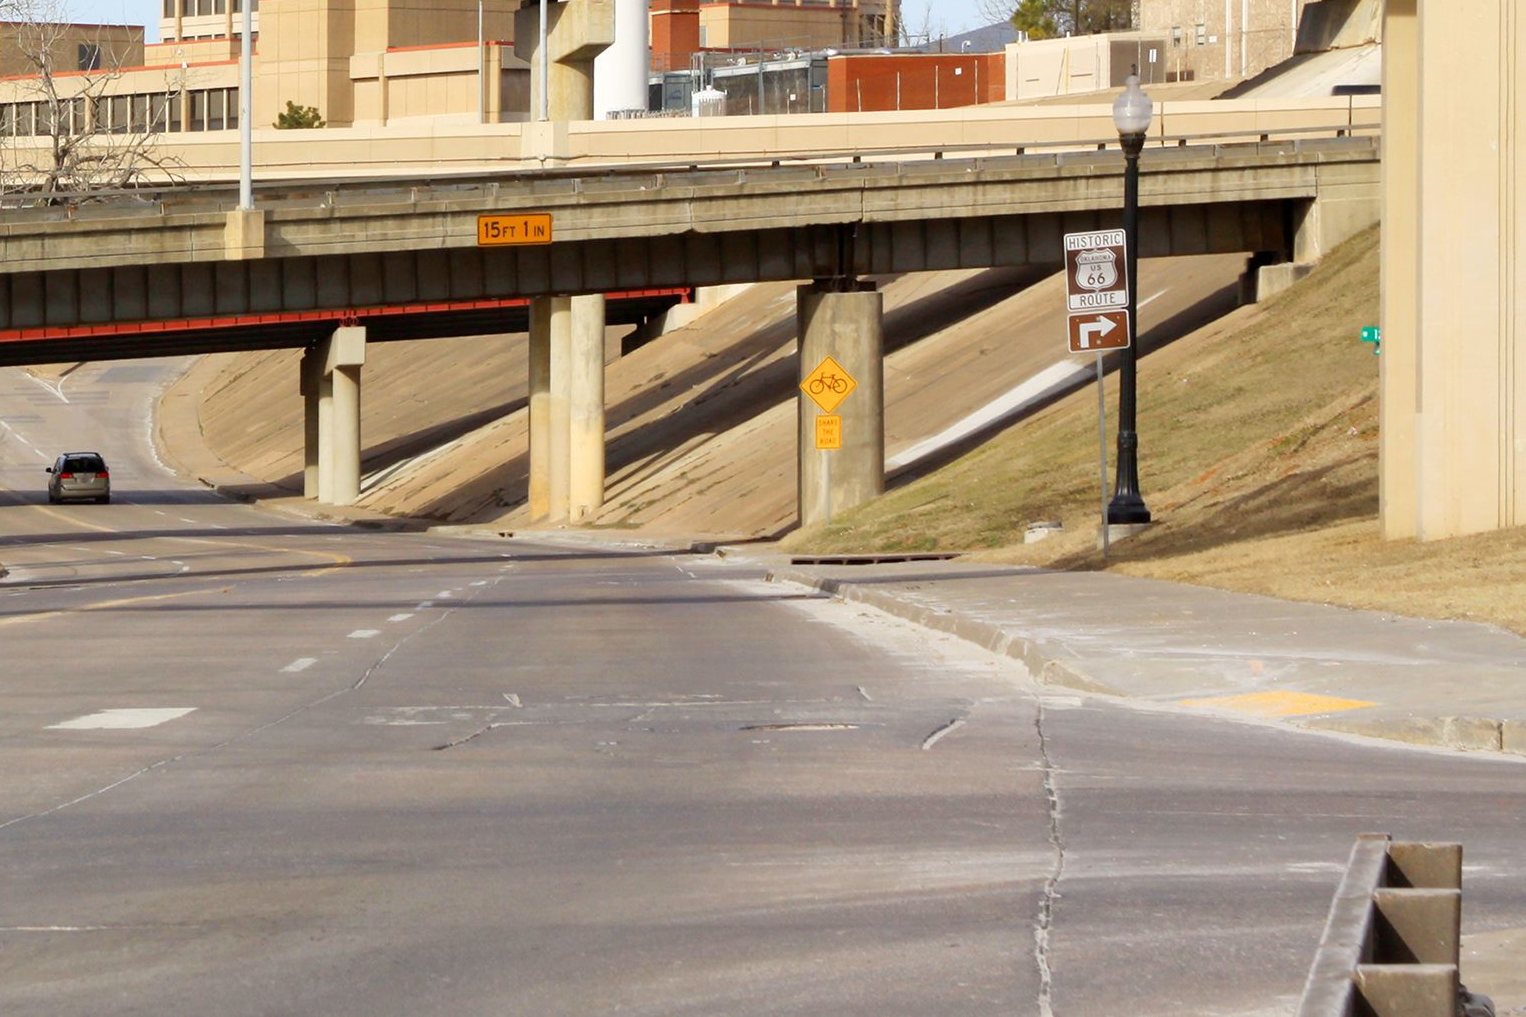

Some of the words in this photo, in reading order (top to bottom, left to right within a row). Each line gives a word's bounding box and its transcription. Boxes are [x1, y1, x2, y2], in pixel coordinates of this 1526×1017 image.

[1068, 233, 1121, 250] HISTORIC
[1079, 254, 1111, 263] OKLAHOMA
[1090, 264, 1102, 272] US
[1087, 272, 1106, 286] 66
[1079, 292, 1116, 307] ROUTE
